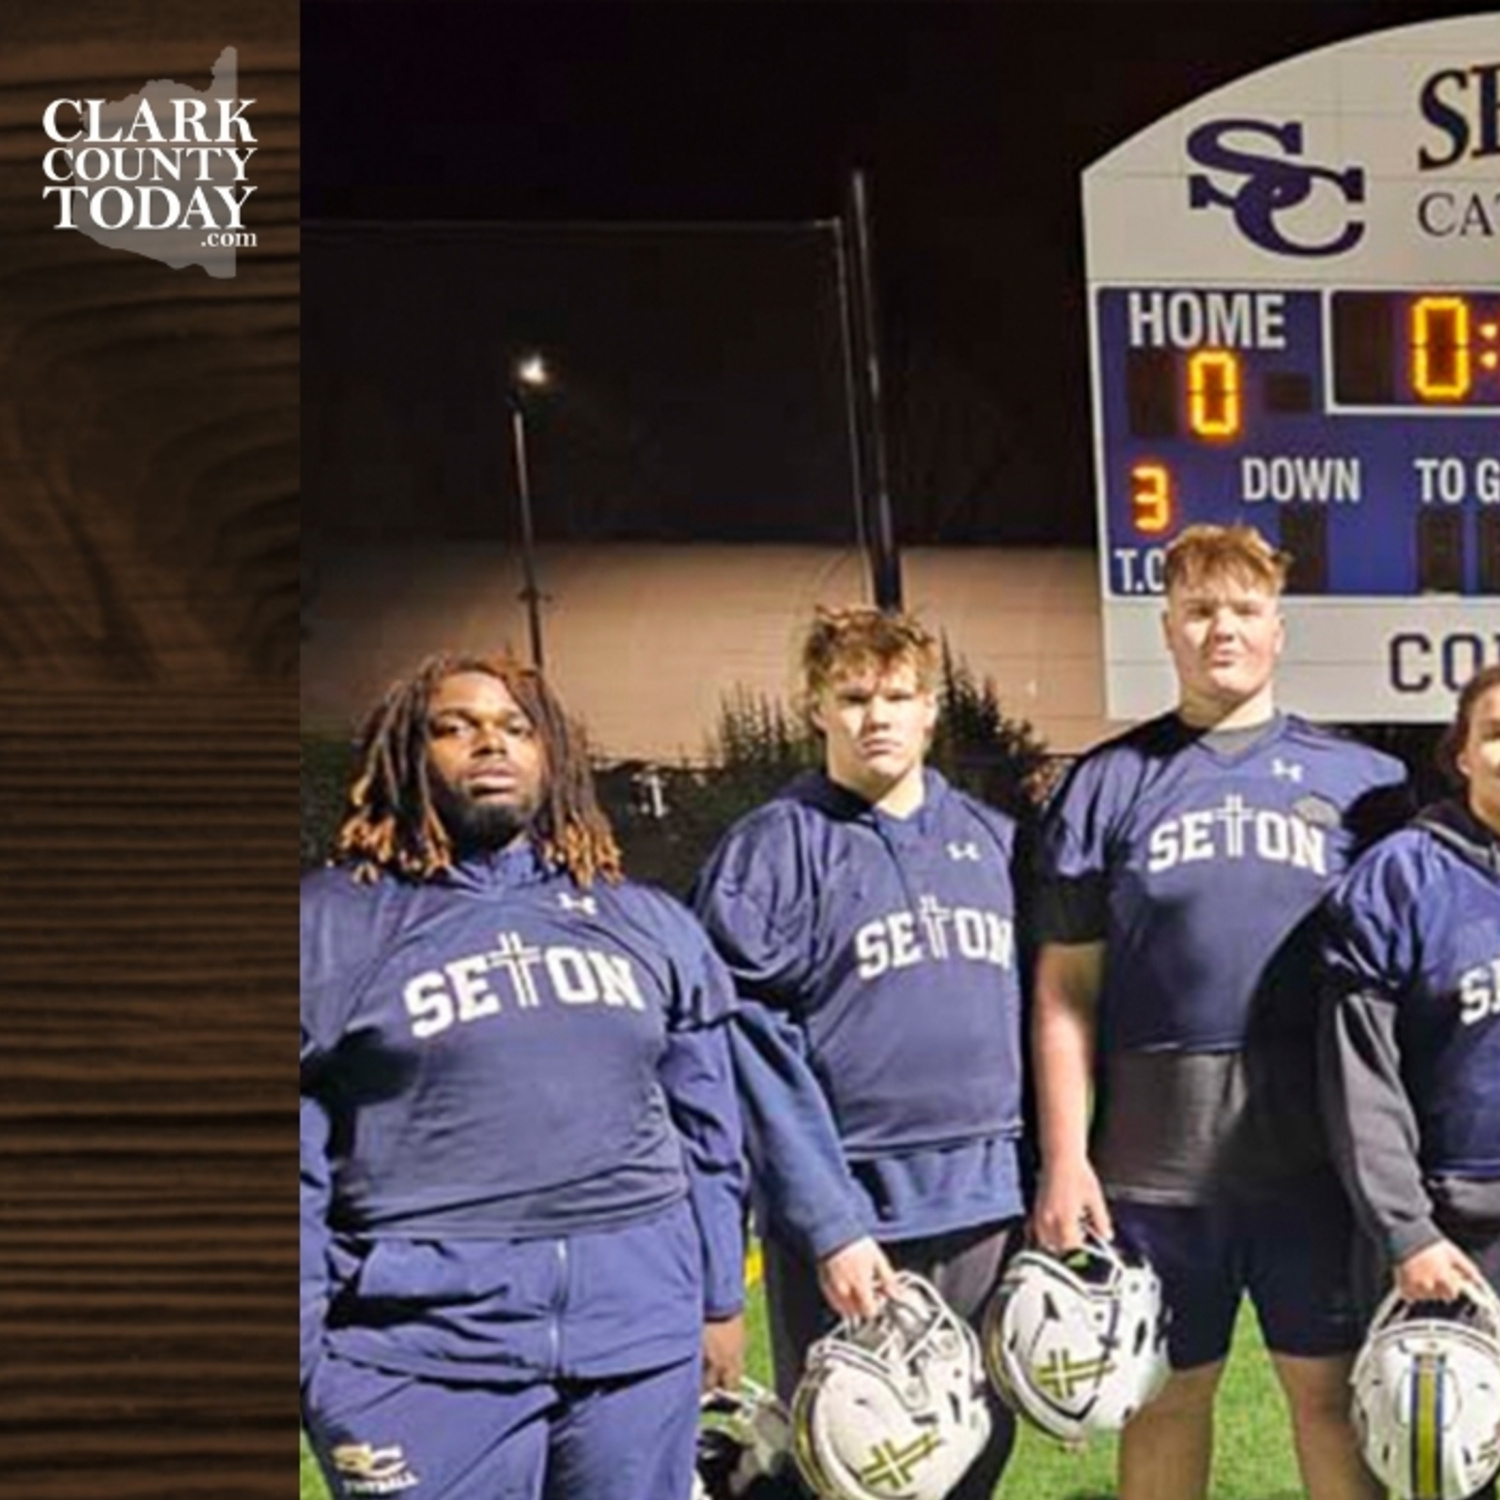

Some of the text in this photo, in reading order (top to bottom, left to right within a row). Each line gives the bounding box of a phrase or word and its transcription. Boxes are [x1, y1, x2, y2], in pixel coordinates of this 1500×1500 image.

[1127, 293, 1287, 349] HOME
[1187, 349, 1239, 436] 0
[1131, 466, 1169, 531] 3
[1242, 458, 1361, 502] DOWN
[1413, 458, 1466, 502] TO
[1148, 794, 1327, 876] SETON
[403, 932, 646, 1037] SETON
